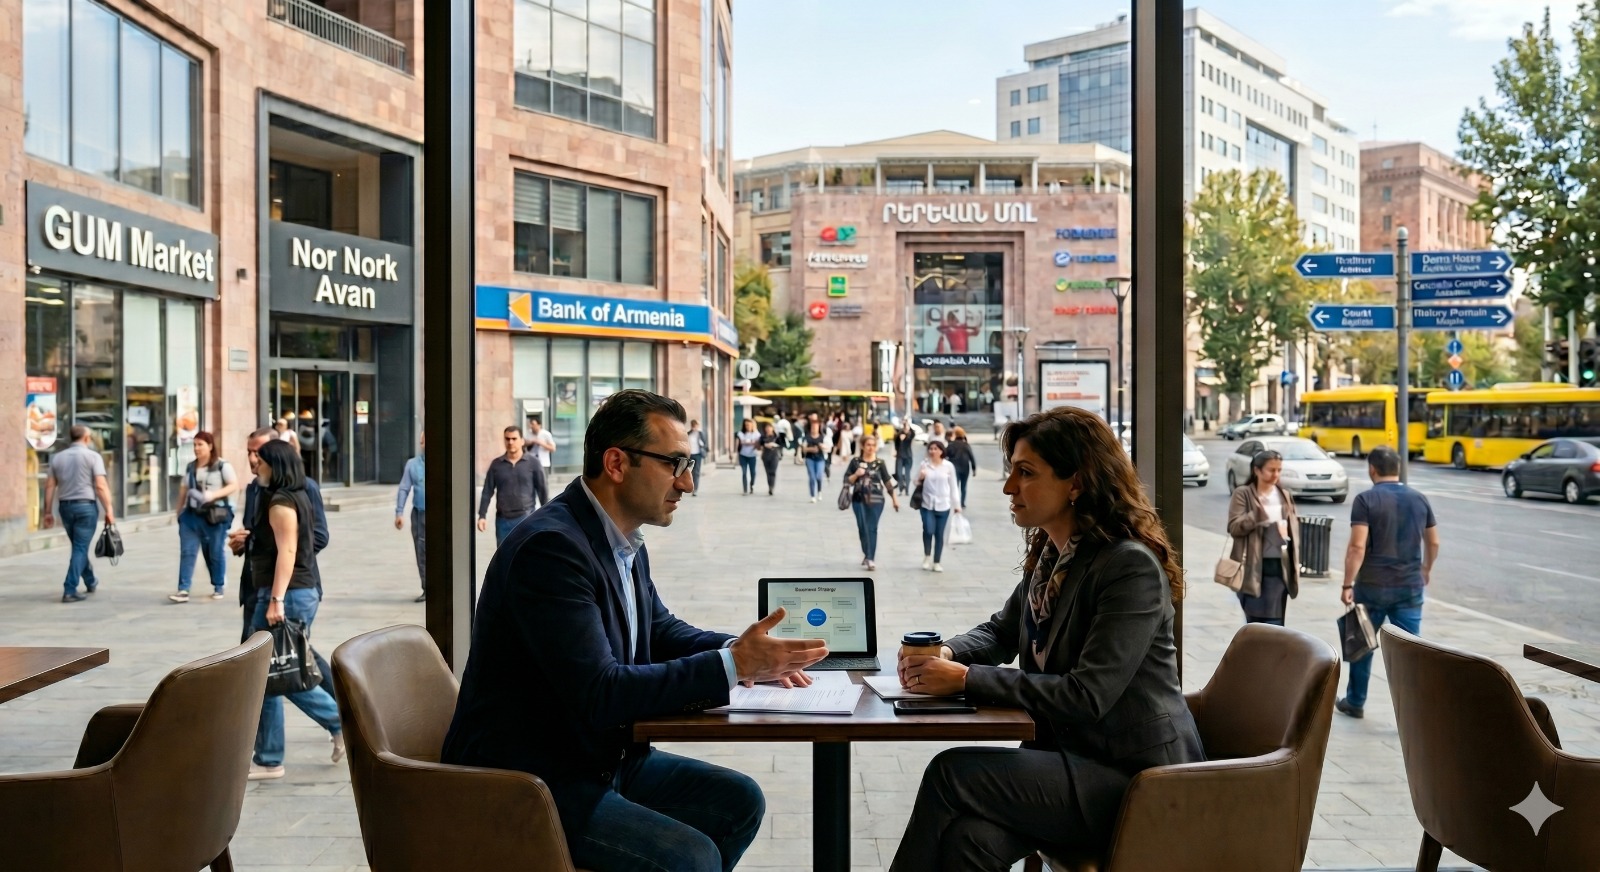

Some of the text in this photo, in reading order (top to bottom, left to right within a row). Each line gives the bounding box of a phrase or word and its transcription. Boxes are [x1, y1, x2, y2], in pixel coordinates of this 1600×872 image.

[994, 202, 1038, 223] ՄՈԼ
[42, 204, 214, 282] GUM Market
[291, 237, 398, 282] Nor Nork
[314, 274, 375, 309] Avan
[538, 297, 685, 328] Bank of Armenia
